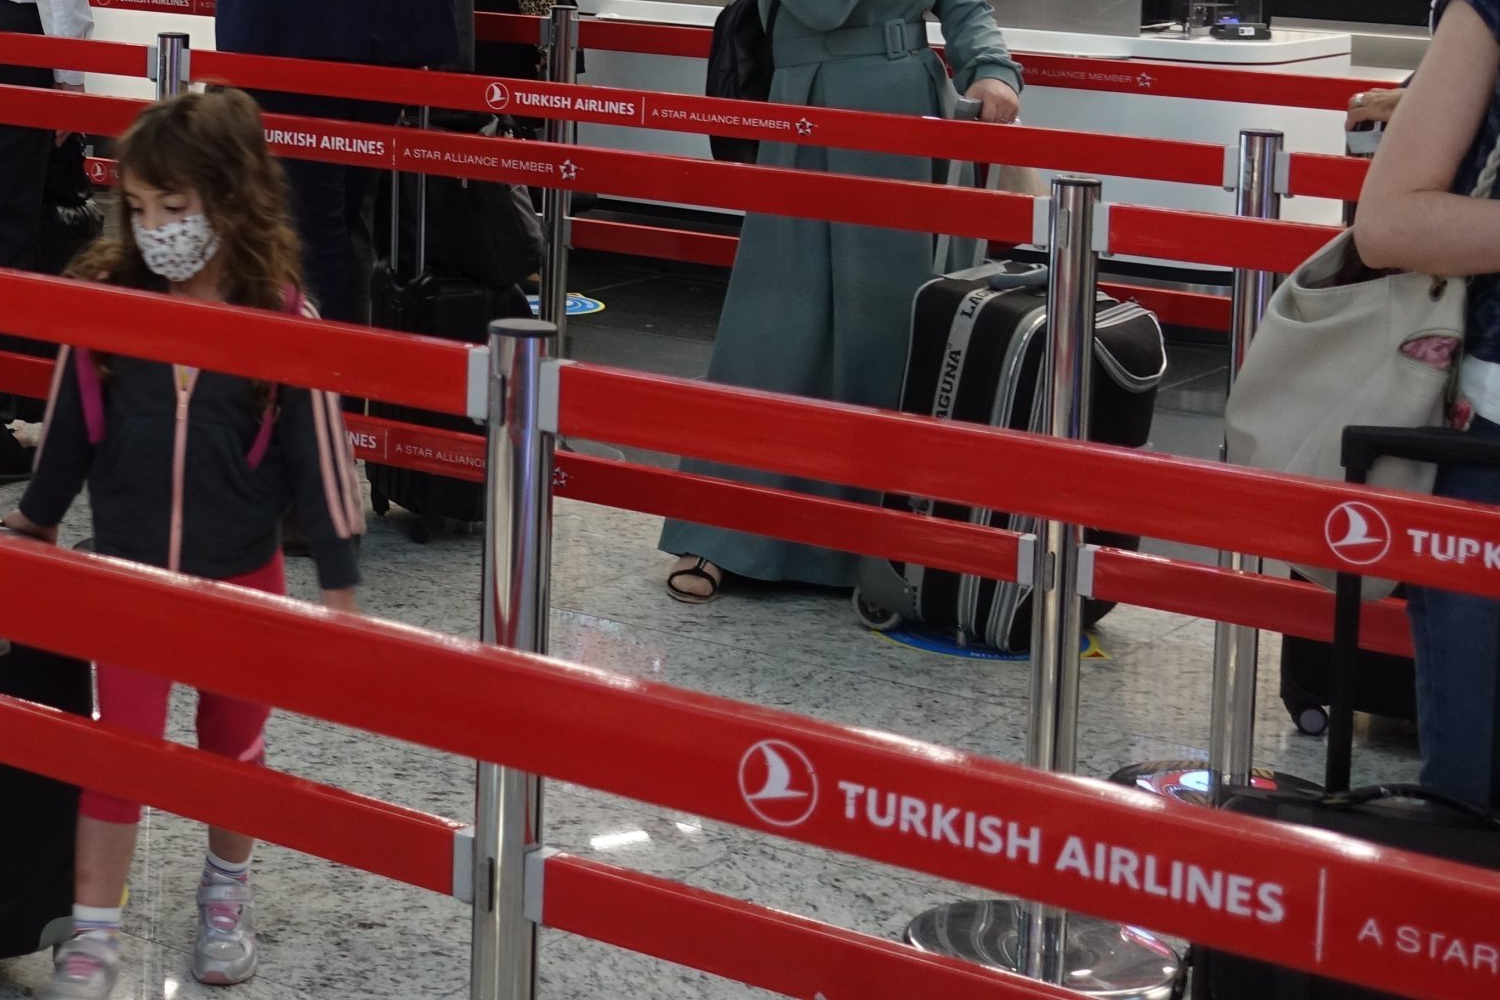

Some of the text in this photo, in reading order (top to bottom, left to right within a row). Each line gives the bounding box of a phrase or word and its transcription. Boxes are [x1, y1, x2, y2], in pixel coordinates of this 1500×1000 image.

[1041, 70, 1132, 83] ALLIANCE MEMBER
[513, 91, 791, 131] TURKISH AIRLINES A STAR ALLIANCE MEMBER
[264, 128, 554, 173] URKISH AIRLINES A STAR ALLIANCE MEMBER
[936, 349, 962, 418] AGUNA
[395, 443, 403, 454] A
[406, 445, 433, 459] STAR
[837, 779, 1499, 975] TURKISH AIRLINES A STAR
